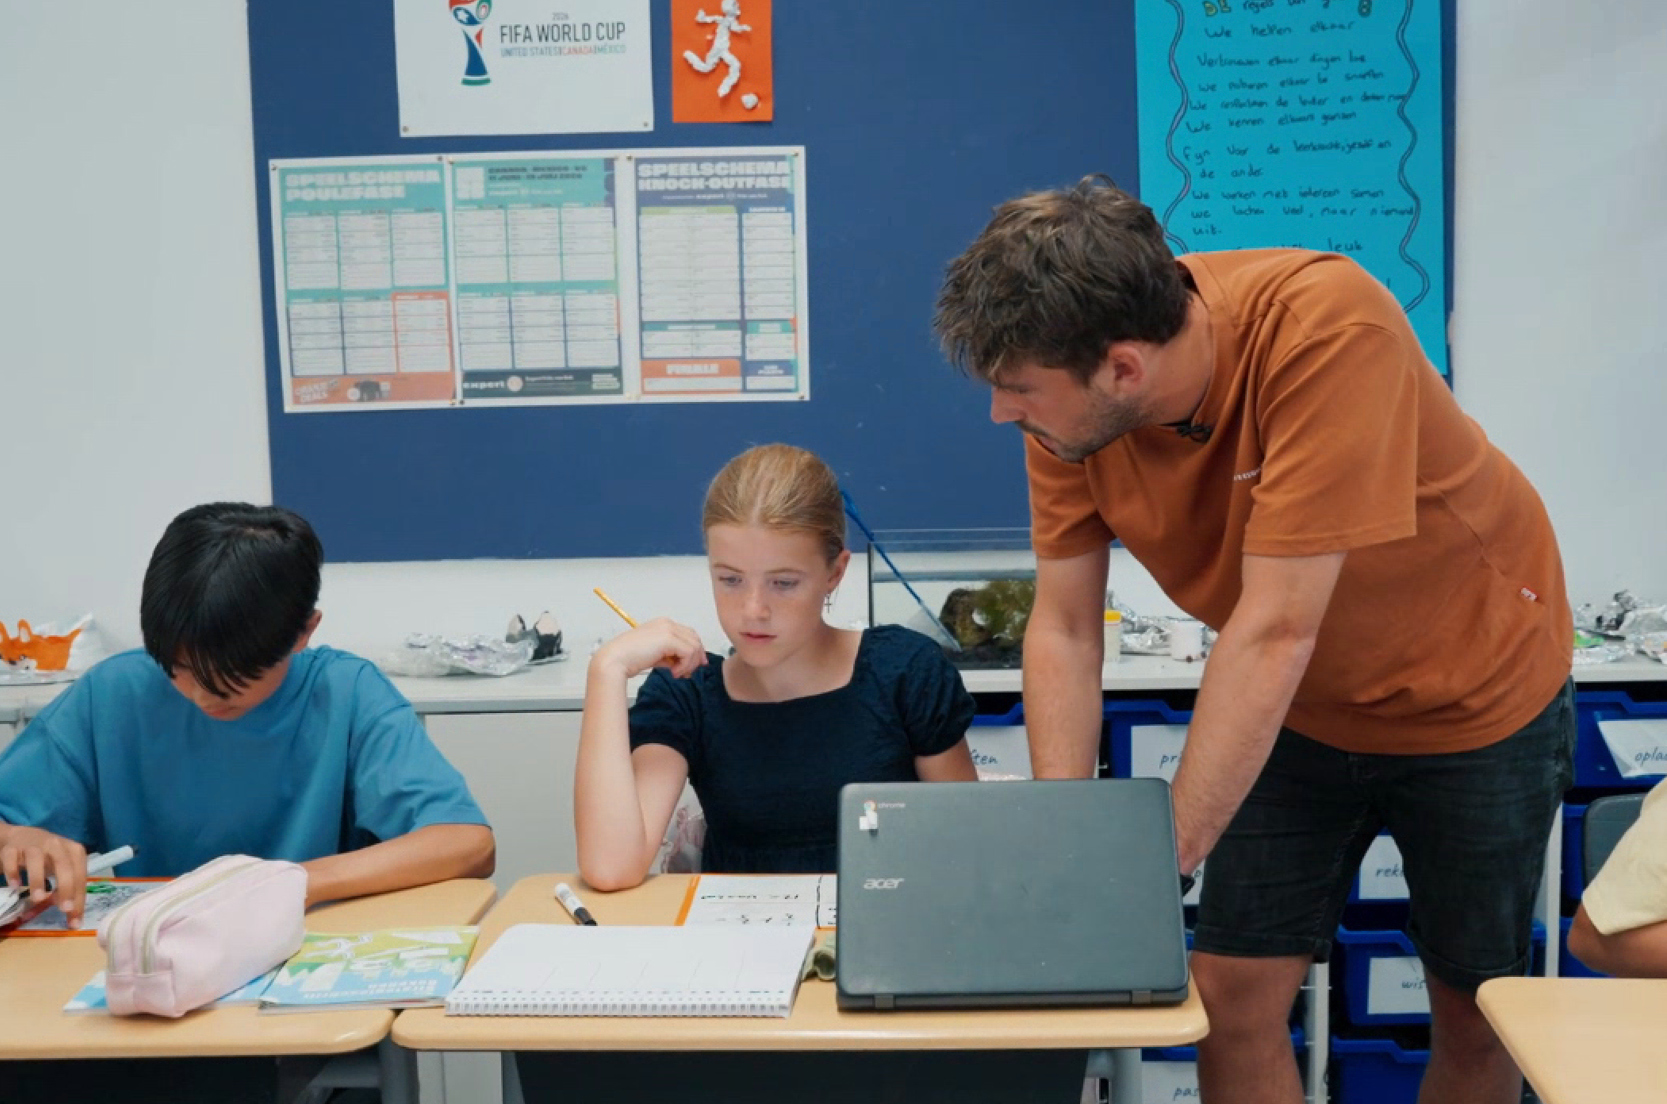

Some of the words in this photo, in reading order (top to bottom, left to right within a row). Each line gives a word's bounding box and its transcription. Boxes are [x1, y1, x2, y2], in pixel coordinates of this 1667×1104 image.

[500, 24, 533, 43] FIFA
[536, 23, 591, 42] WORLD
[596, 22, 625, 41] CUP
[1204, 26, 1232, 38] We
[501, 46, 528, 57] UNITED
[530, 45, 560, 56] STATES
[1185, 120, 1211, 134] We
[638, 161, 789, 177] SPEELSCHEMA
[1199, 168, 1215, 179] de
[1262, 188, 1289, 199] met
[463, 380, 505, 390] expert
[877, 801, 906, 809] chrome
[863, 877, 905, 890] acer
